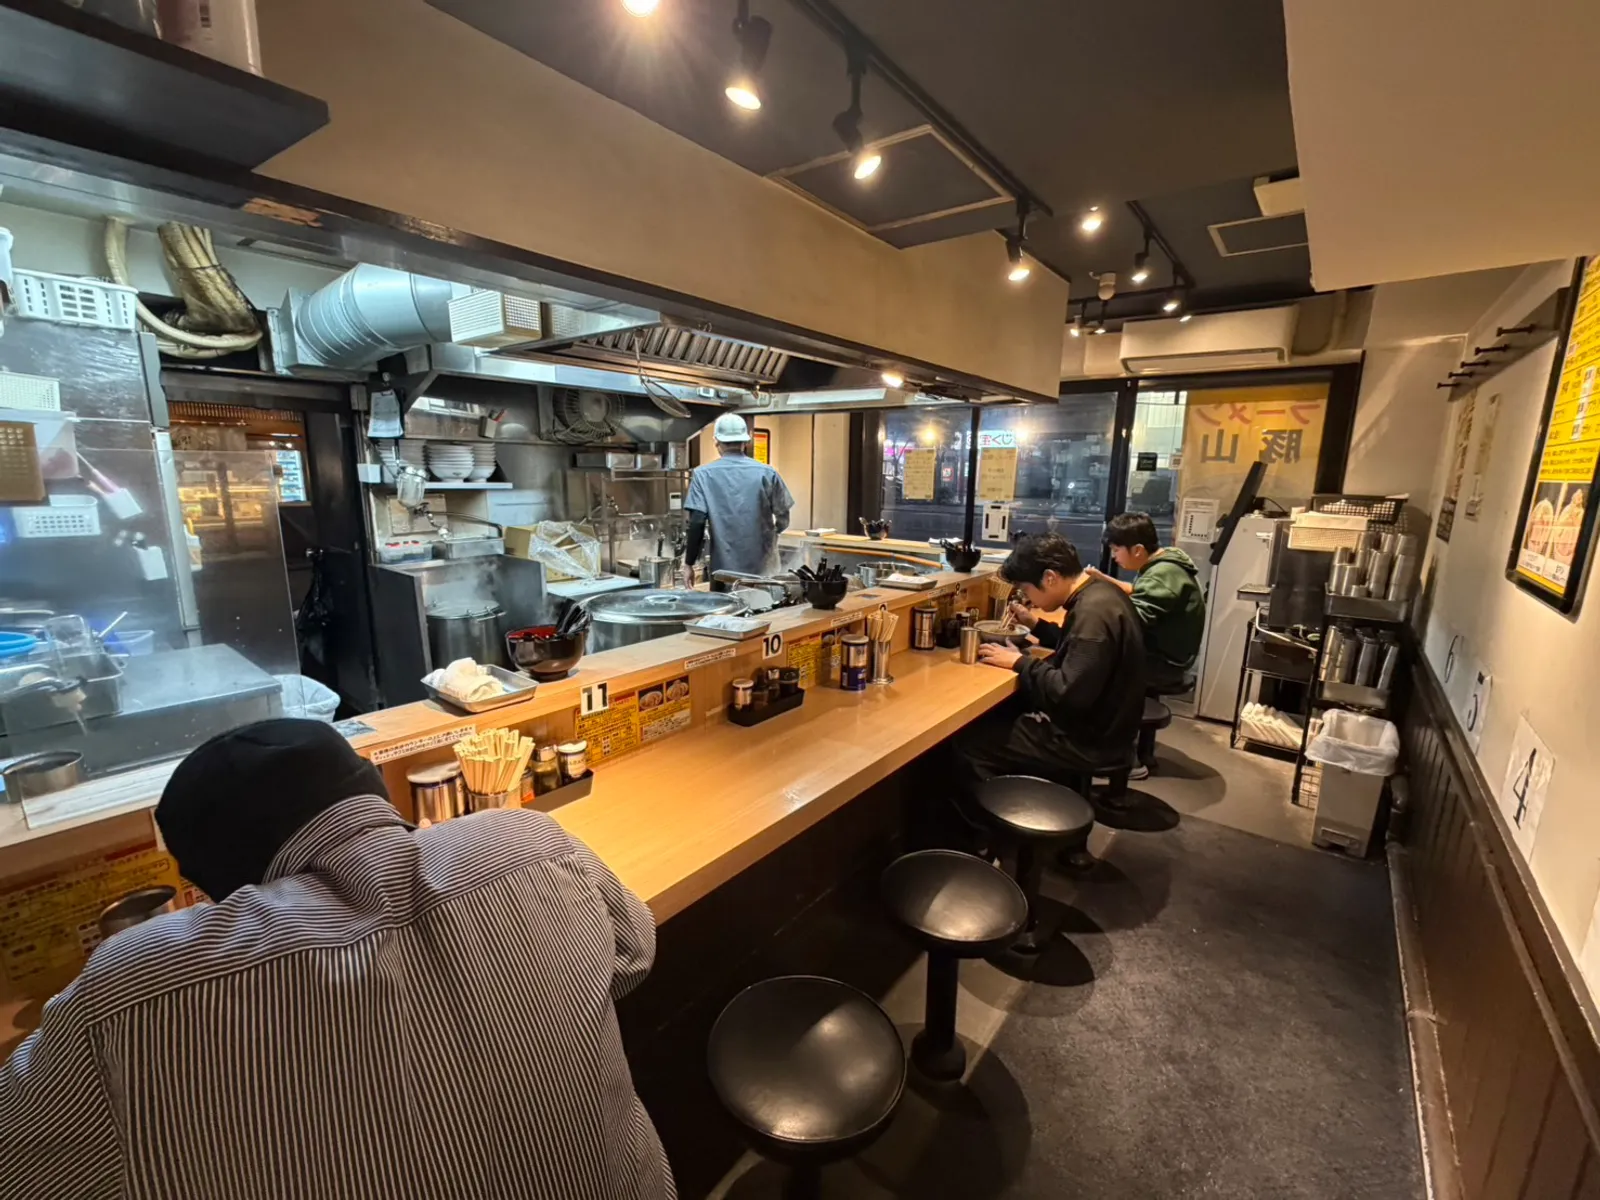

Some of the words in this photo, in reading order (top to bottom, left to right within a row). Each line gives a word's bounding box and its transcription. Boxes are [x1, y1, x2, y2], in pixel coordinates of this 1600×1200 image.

[979, 434, 1013, 446] 宝くじ
[763, 634, 782, 657] 10
[582, 682, 608, 711] 11
